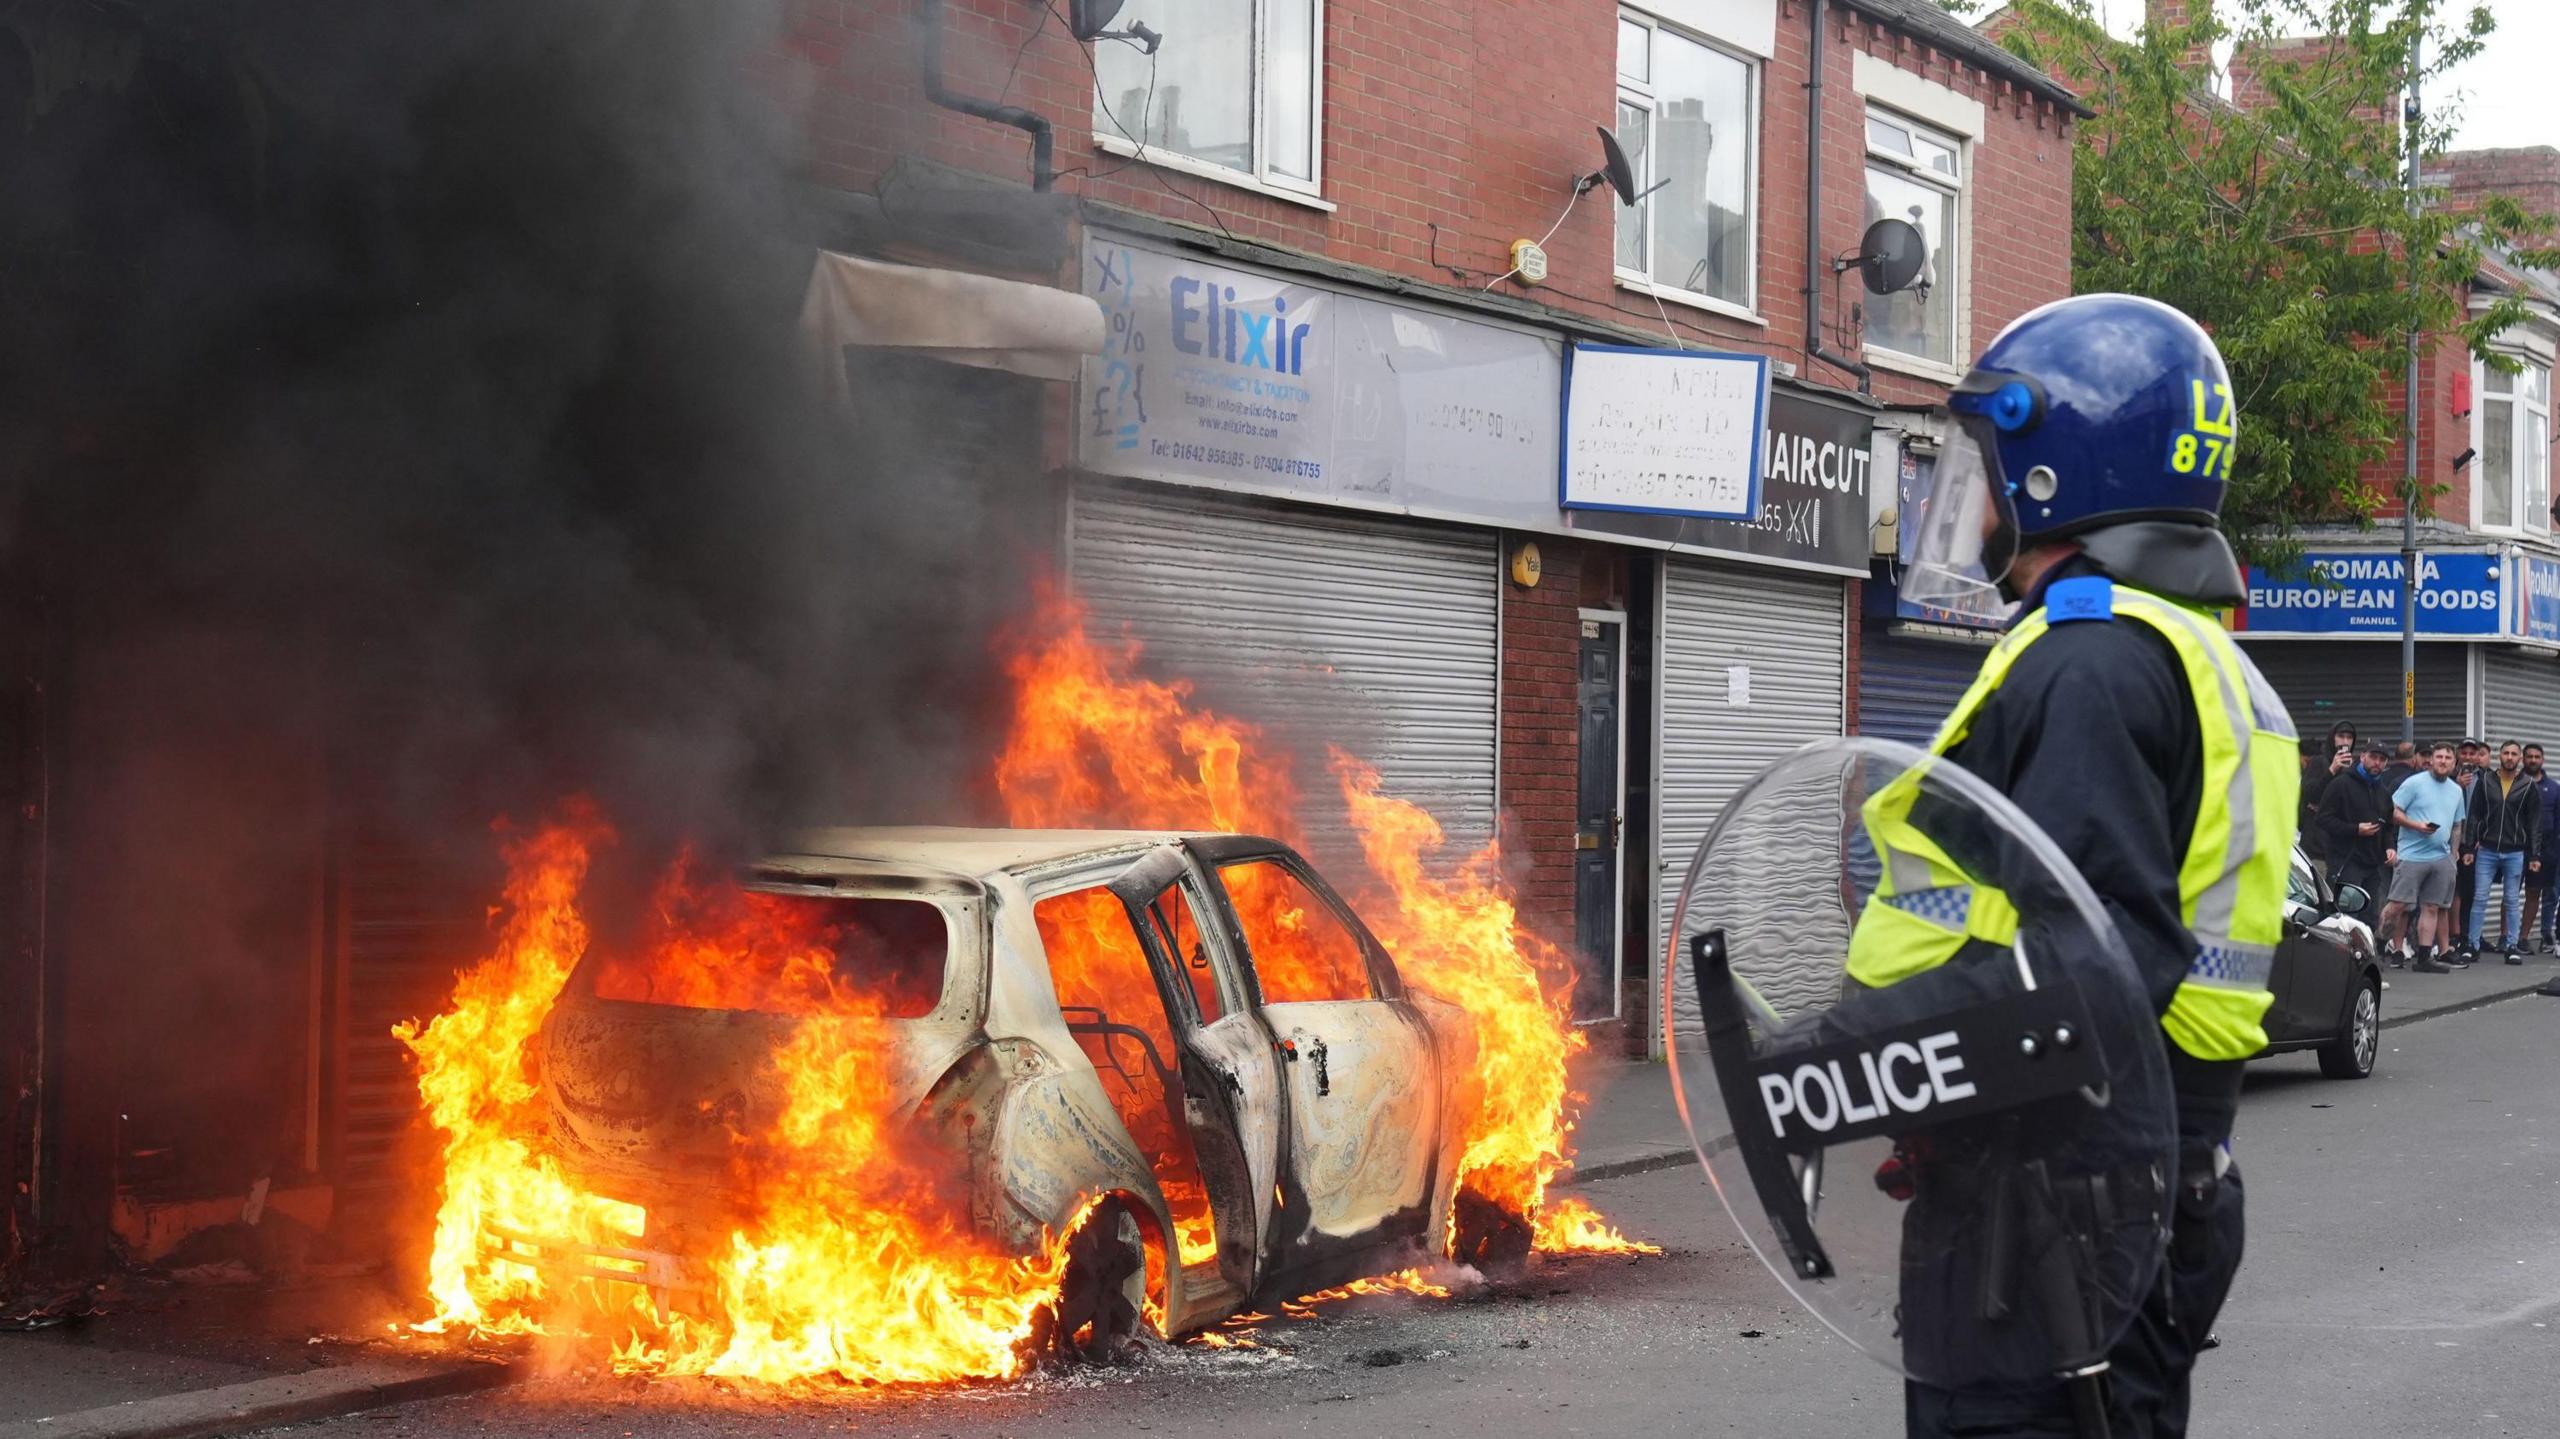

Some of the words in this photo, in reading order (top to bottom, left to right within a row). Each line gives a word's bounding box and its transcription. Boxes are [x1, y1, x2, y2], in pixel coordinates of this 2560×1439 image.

[1170, 276, 1310, 376] Elixir
[2192, 379, 2233, 438] LZ
[1173, 442, 1204, 462] 01642
[2313, 559, 2440, 580] ROMANA
[2249, 588, 2395, 610] EUROPEAN
[2350, 616, 2397, 626] EMANUEL
[1758, 1031, 1977, 1138] POLICE
